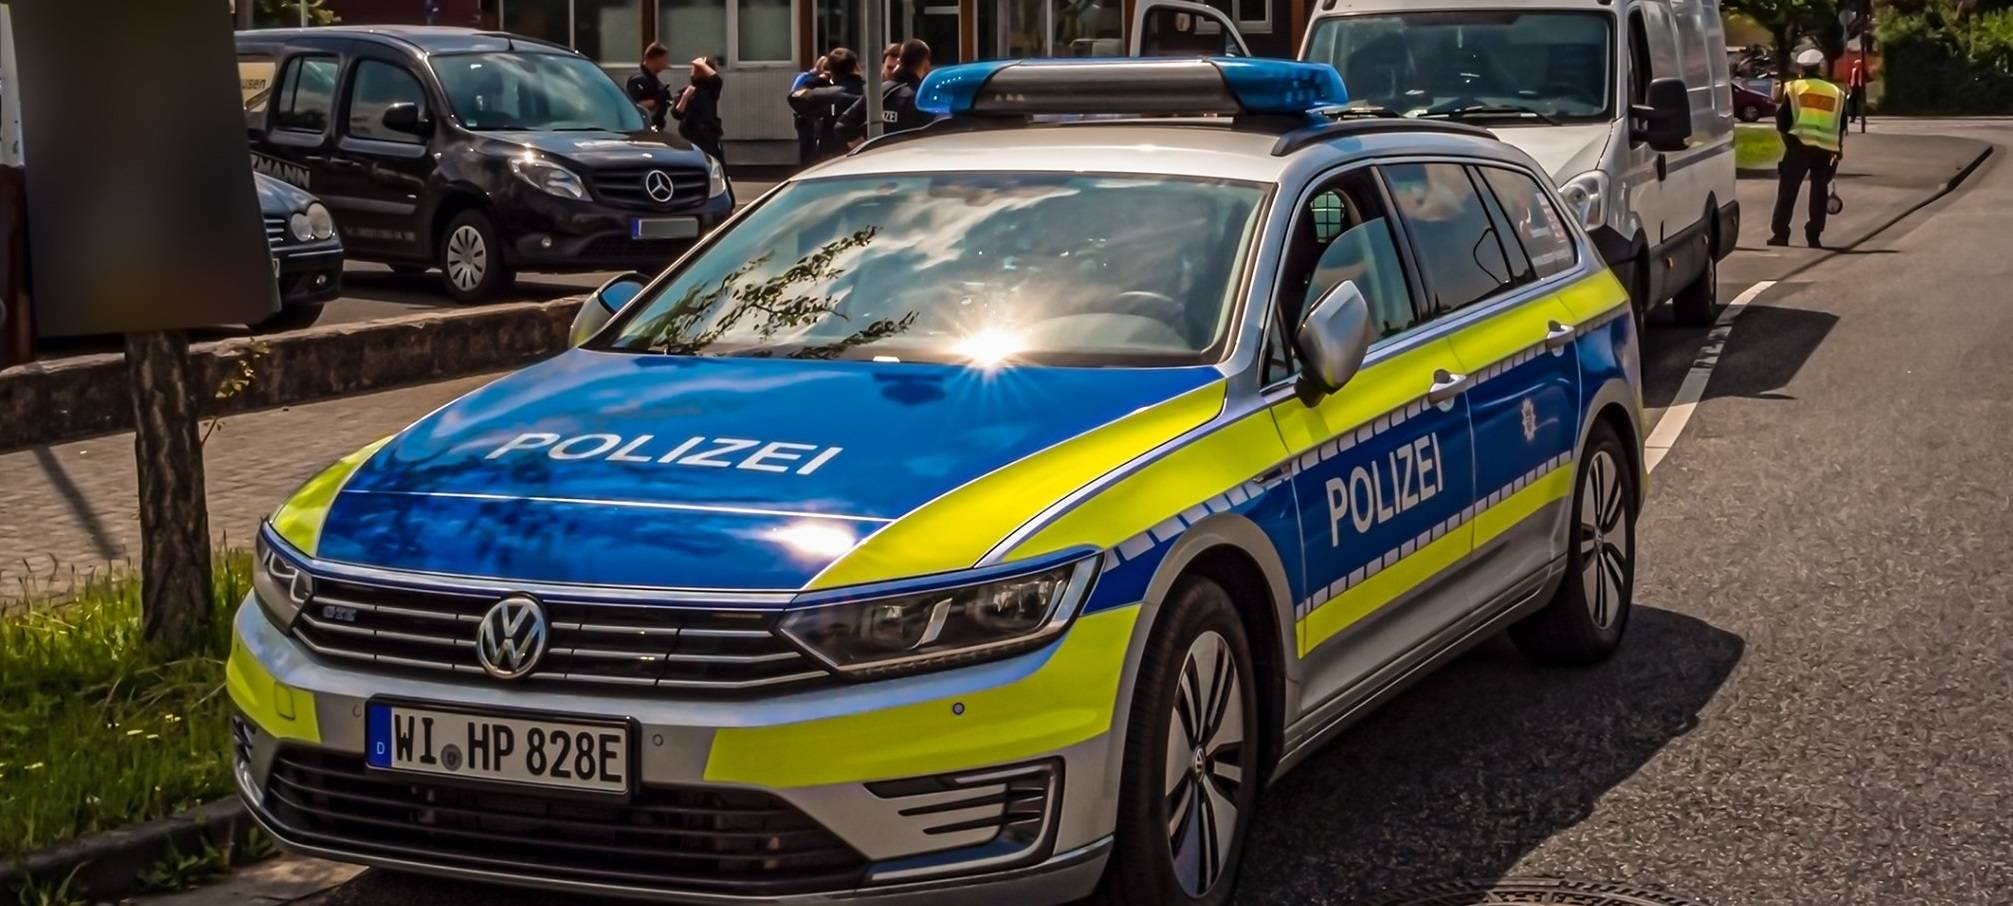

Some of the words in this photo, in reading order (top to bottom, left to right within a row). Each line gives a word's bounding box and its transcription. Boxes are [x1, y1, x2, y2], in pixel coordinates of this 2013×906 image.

[484, 432, 843, 475] POLIZEI
[1325, 432, 1443, 547] POLIZEI
[376, 741, 385, 754] D
[394, 714, 437, 765] WI
[467, 721, 515, 772] HP
[525, 727, 622, 784] 828E
